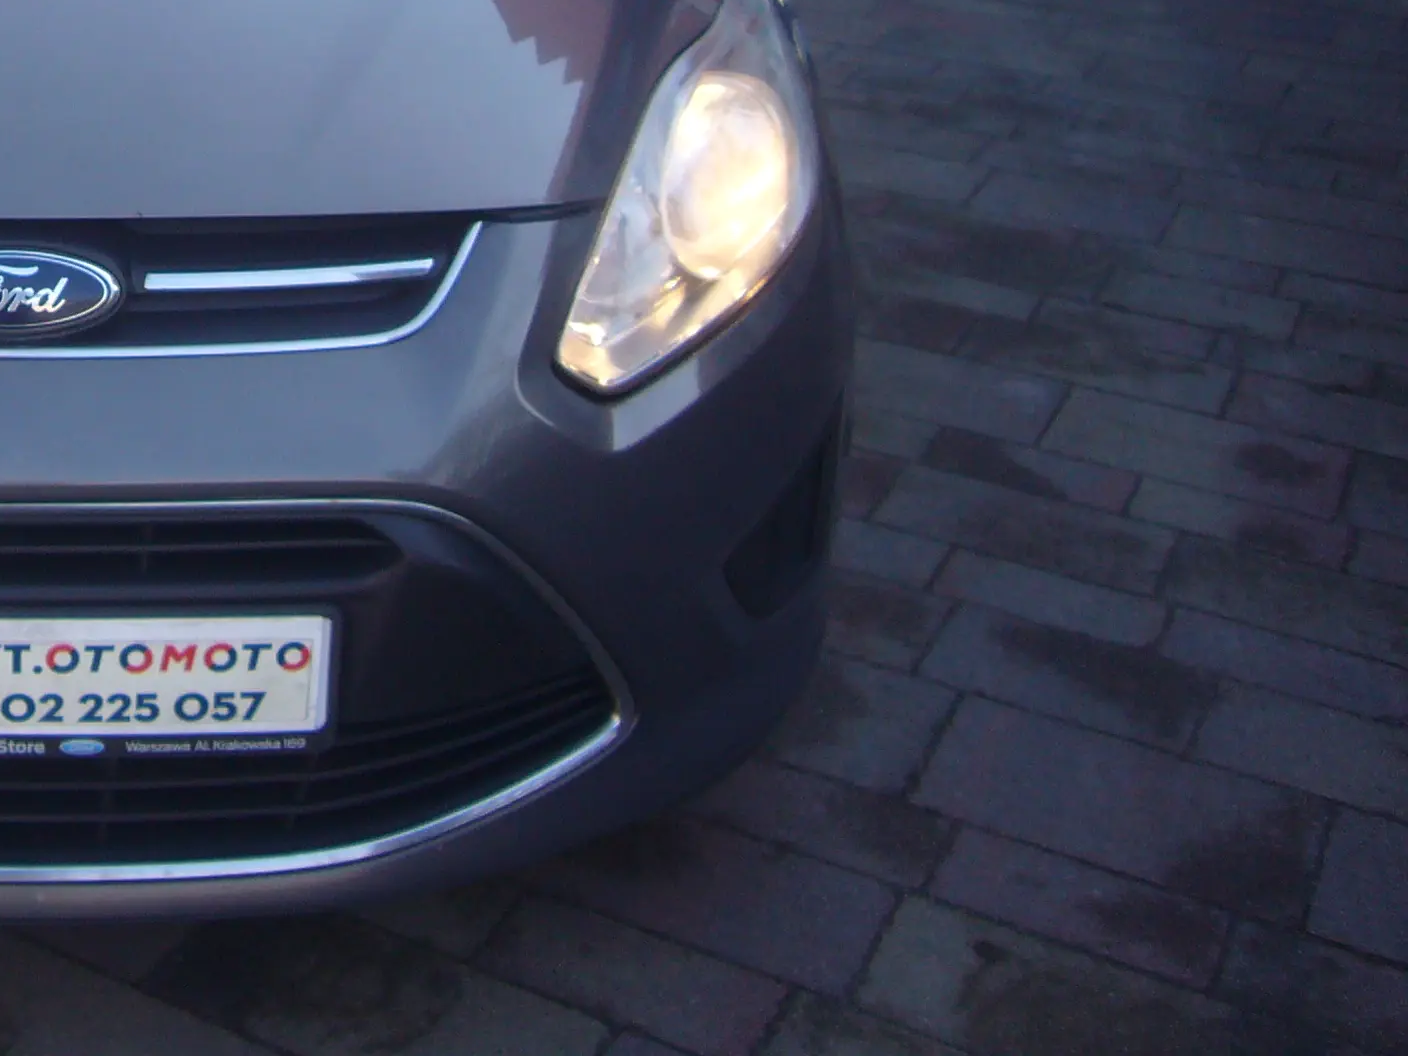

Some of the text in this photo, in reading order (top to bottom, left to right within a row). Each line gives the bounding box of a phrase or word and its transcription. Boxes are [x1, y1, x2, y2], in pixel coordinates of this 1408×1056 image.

[78, 692, 161, 723] 225
[173, 691, 267, 723] 057
[124, 740, 191, 753] Warszawa
